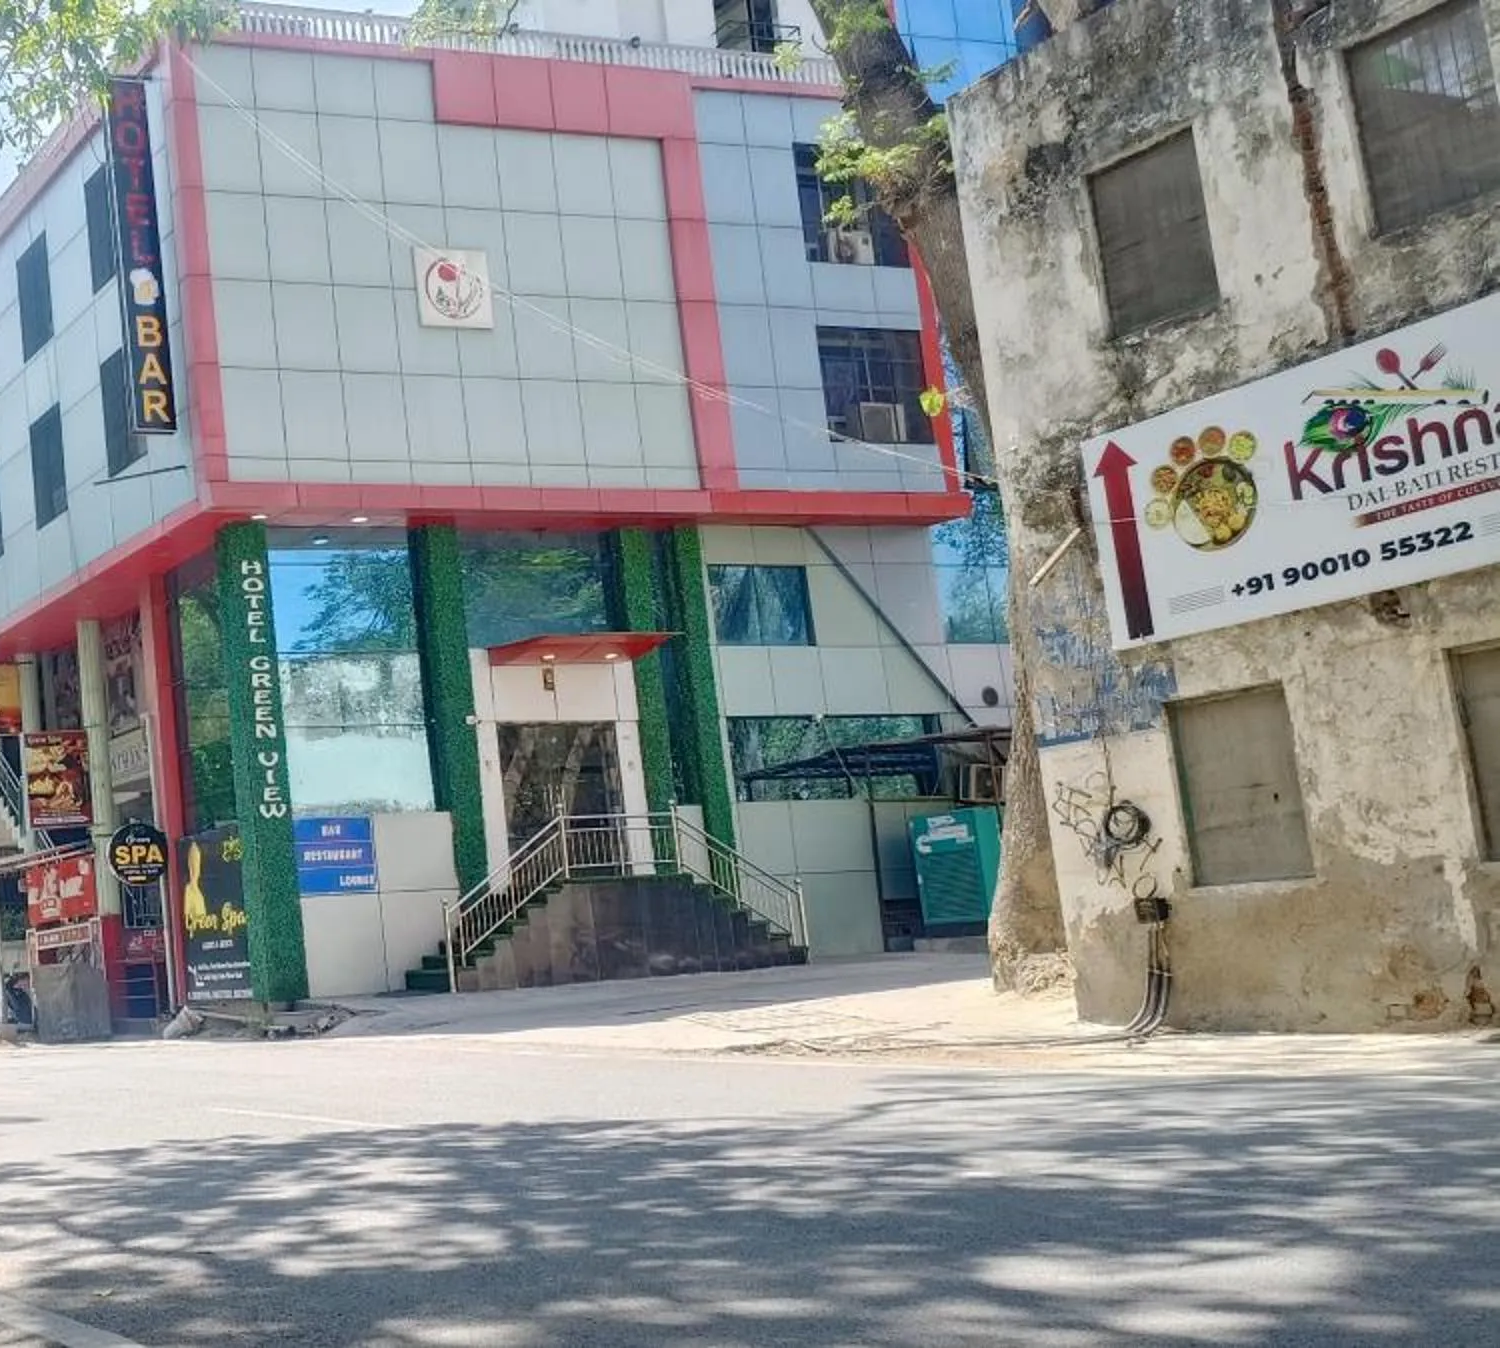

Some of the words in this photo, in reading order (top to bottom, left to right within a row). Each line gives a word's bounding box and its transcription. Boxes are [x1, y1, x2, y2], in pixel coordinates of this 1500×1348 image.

[136, 314, 170, 424] BAR
[1284, 400, 1500, 500] Krishn
[1231, 570, 1275, 596] +91
[1282, 548, 1372, 588] 90010
[1379, 520, 1475, 562] 55322
[241, 561, 266, 644] HOTEL
[250, 656, 277, 739] GREEN
[258, 751, 287, 820] VIEW
[115, 844, 164, 865] SPA
[221, 901, 248, 936] Spa
